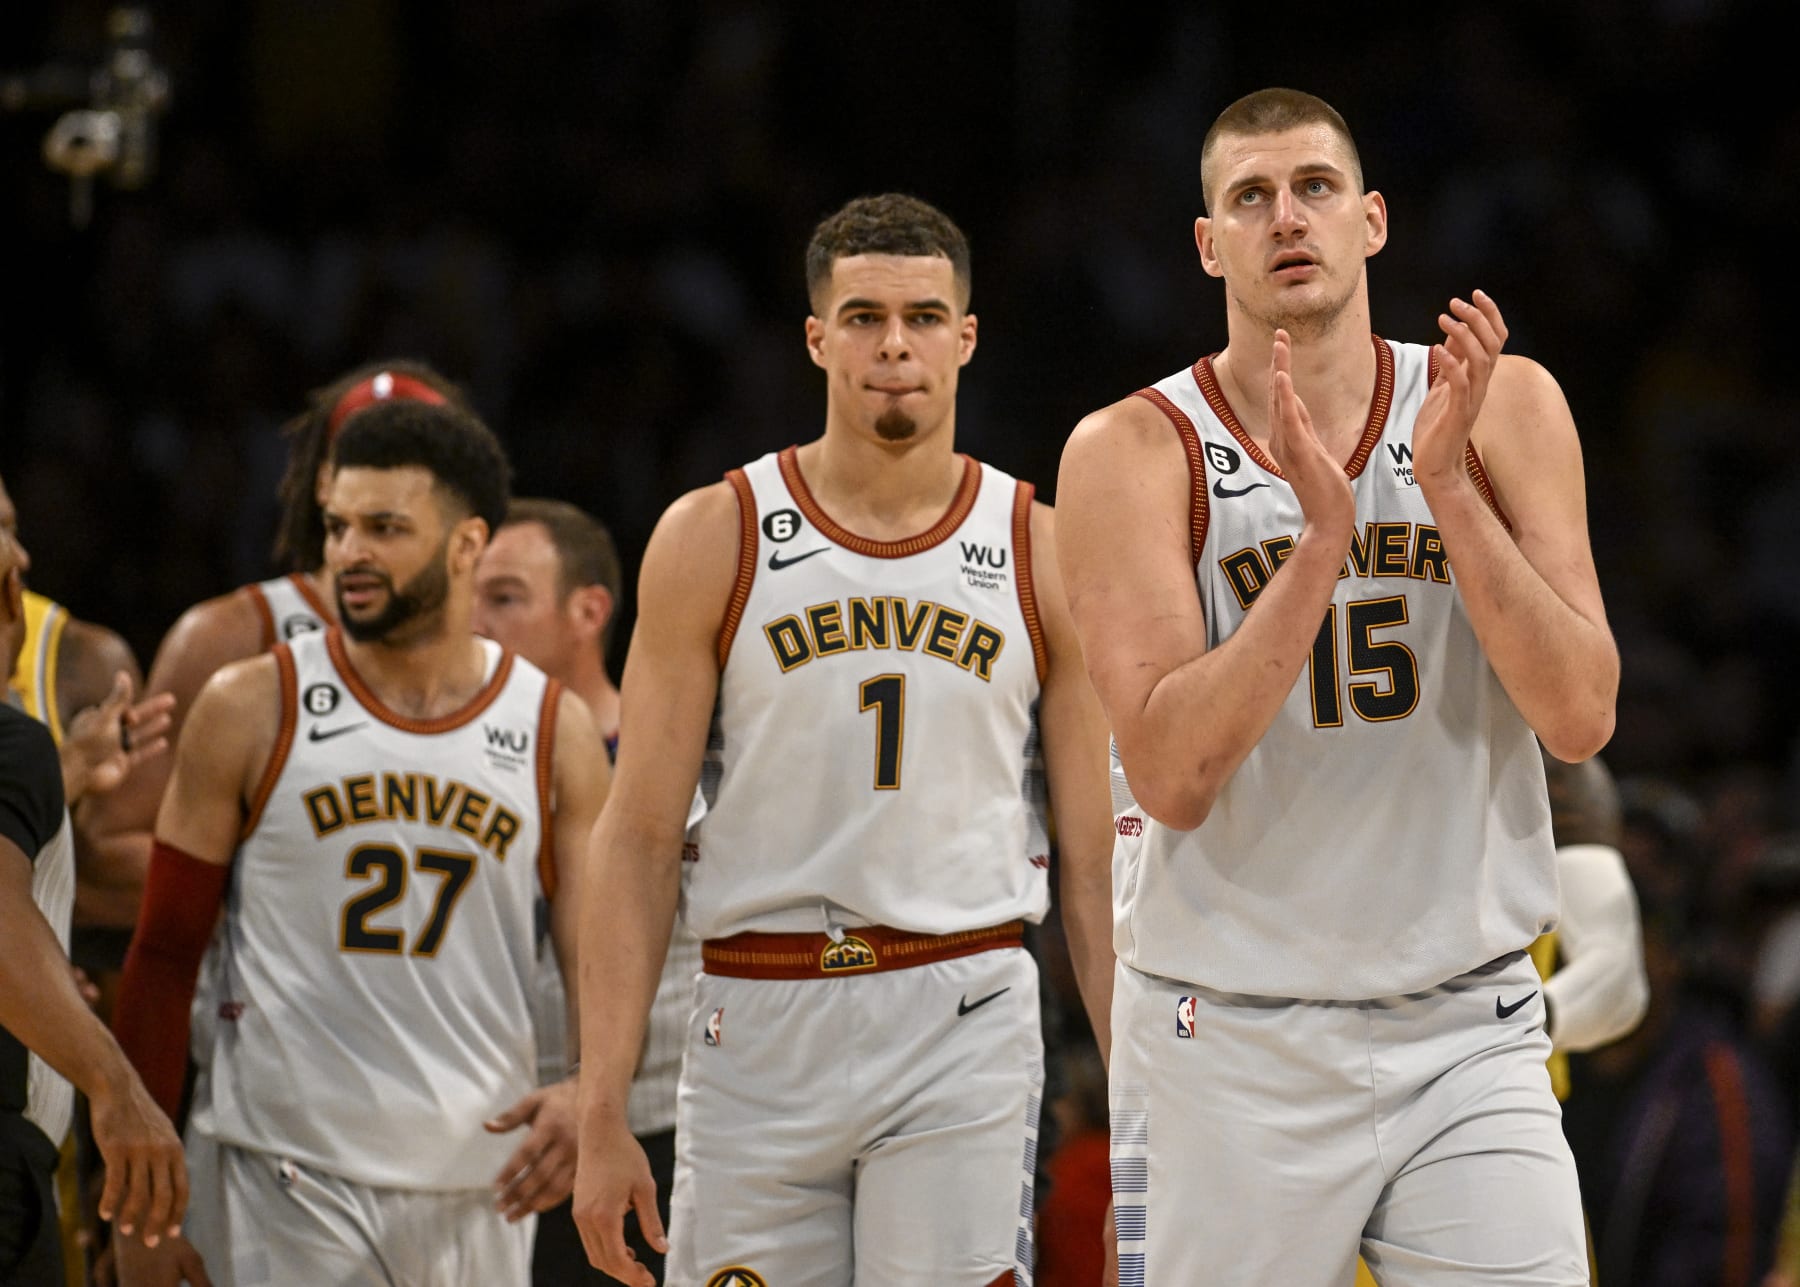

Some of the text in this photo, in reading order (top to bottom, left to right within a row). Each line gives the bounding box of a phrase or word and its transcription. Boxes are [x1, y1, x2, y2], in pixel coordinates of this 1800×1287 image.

[1209, 446, 1231, 472] 6
[771, 512, 793, 539] 6
[960, 541, 1006, 568] WU
[960, 564, 1007, 581] Western
[967, 575, 1000, 590] Union
[763, 596, 1006, 683] DENVER
[1309, 594, 1421, 728] 15
[311, 687, 333, 713] 6
[484, 723, 528, 754] WU
[859, 673, 906, 790] 1
[303, 772, 524, 863] DENVER
[339, 840, 479, 960] 27
